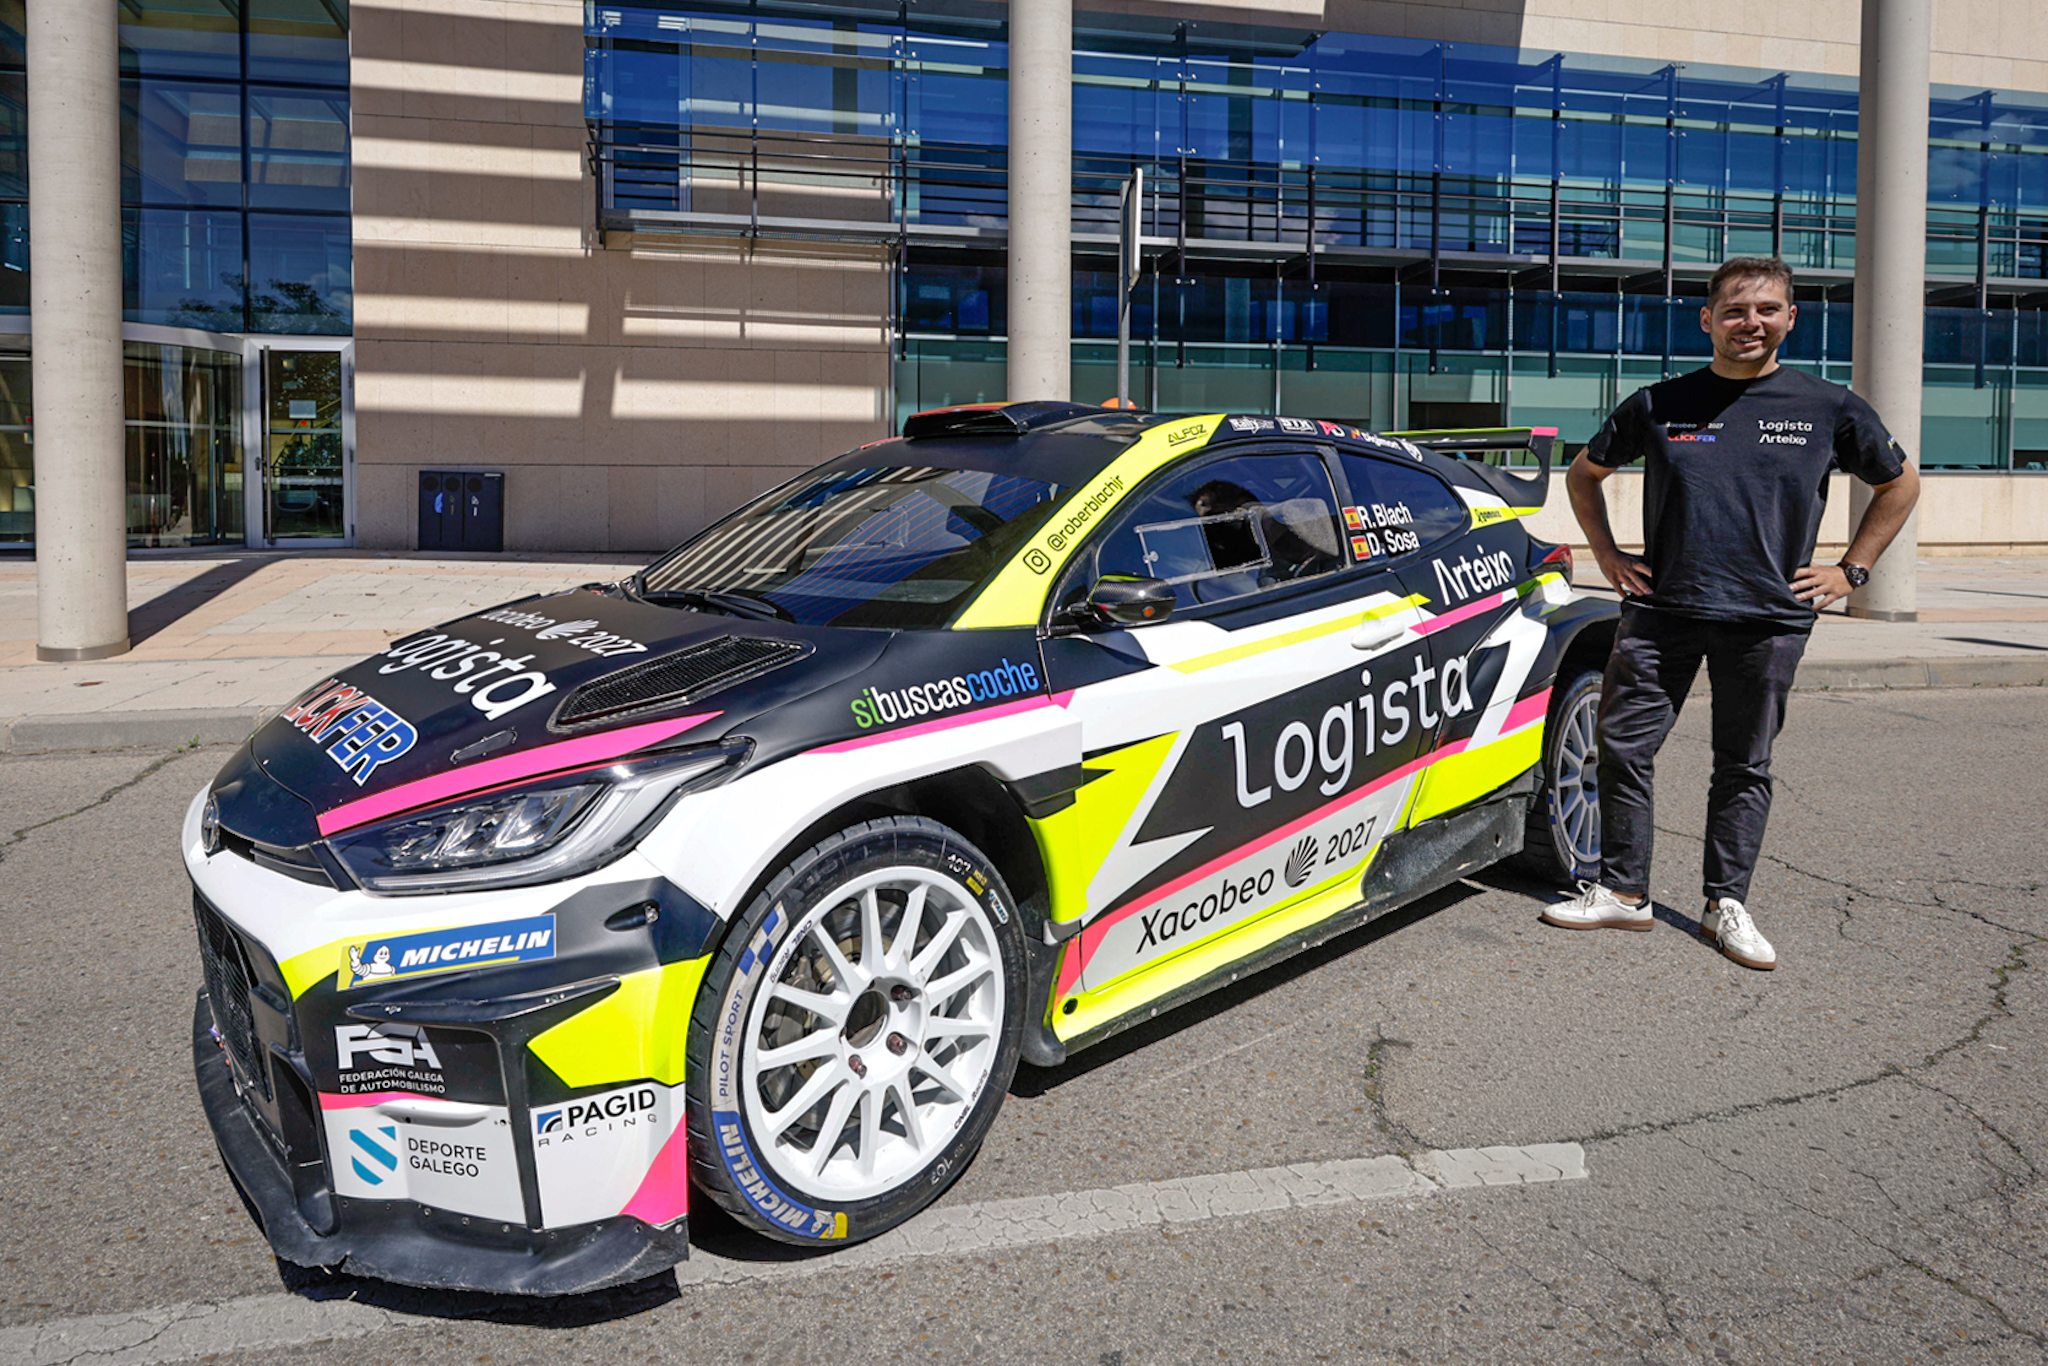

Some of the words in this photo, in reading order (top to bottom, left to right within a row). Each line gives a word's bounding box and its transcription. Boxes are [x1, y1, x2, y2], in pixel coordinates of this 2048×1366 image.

[1168, 424, 1208, 443] ALFOZ
[1707, 422, 1725, 430] 2027
[1758, 419, 1813, 432] Logista
[1758, 434, 1808, 446] Arteixo
[1046, 474, 1125, 553] @roberblachjr
[1356, 505, 1377, 530] R.
[1371, 501, 1413, 528] Blach
[1366, 532, 1386, 557] D.
[1384, 529, 1420, 554] Sosa
[1432, 544, 1517, 606] Arteixo
[568, 630, 649, 657] 2027
[377, 634, 558, 721] ogista
[850, 658, 1040, 729] sibuscascoche
[1220, 654, 1475, 809] Logista
[1136, 868, 1275, 954] Xacobeo
[1324, 815, 1378, 866] 2027
[399, 929, 552, 968] MICHELIN
[723, 990, 744, 1046] SPORT
[339, 1067, 406, 1083] FEDERACIÓN
[407, 1071, 445, 1084] GALEGA
[340, 1084, 358, 1094] DE
[359, 1080, 446, 1094] AUTOMOBILISMO
[719, 1048, 735, 1097] PILOT
[568, 1088, 657, 1128] PAGID
[538, 1113, 658, 1148] RACING
[407, 1137, 488, 1162] DEPORTE
[409, 1156, 480, 1179] GALEGO
[718, 1122, 810, 1229] MICHELIN
